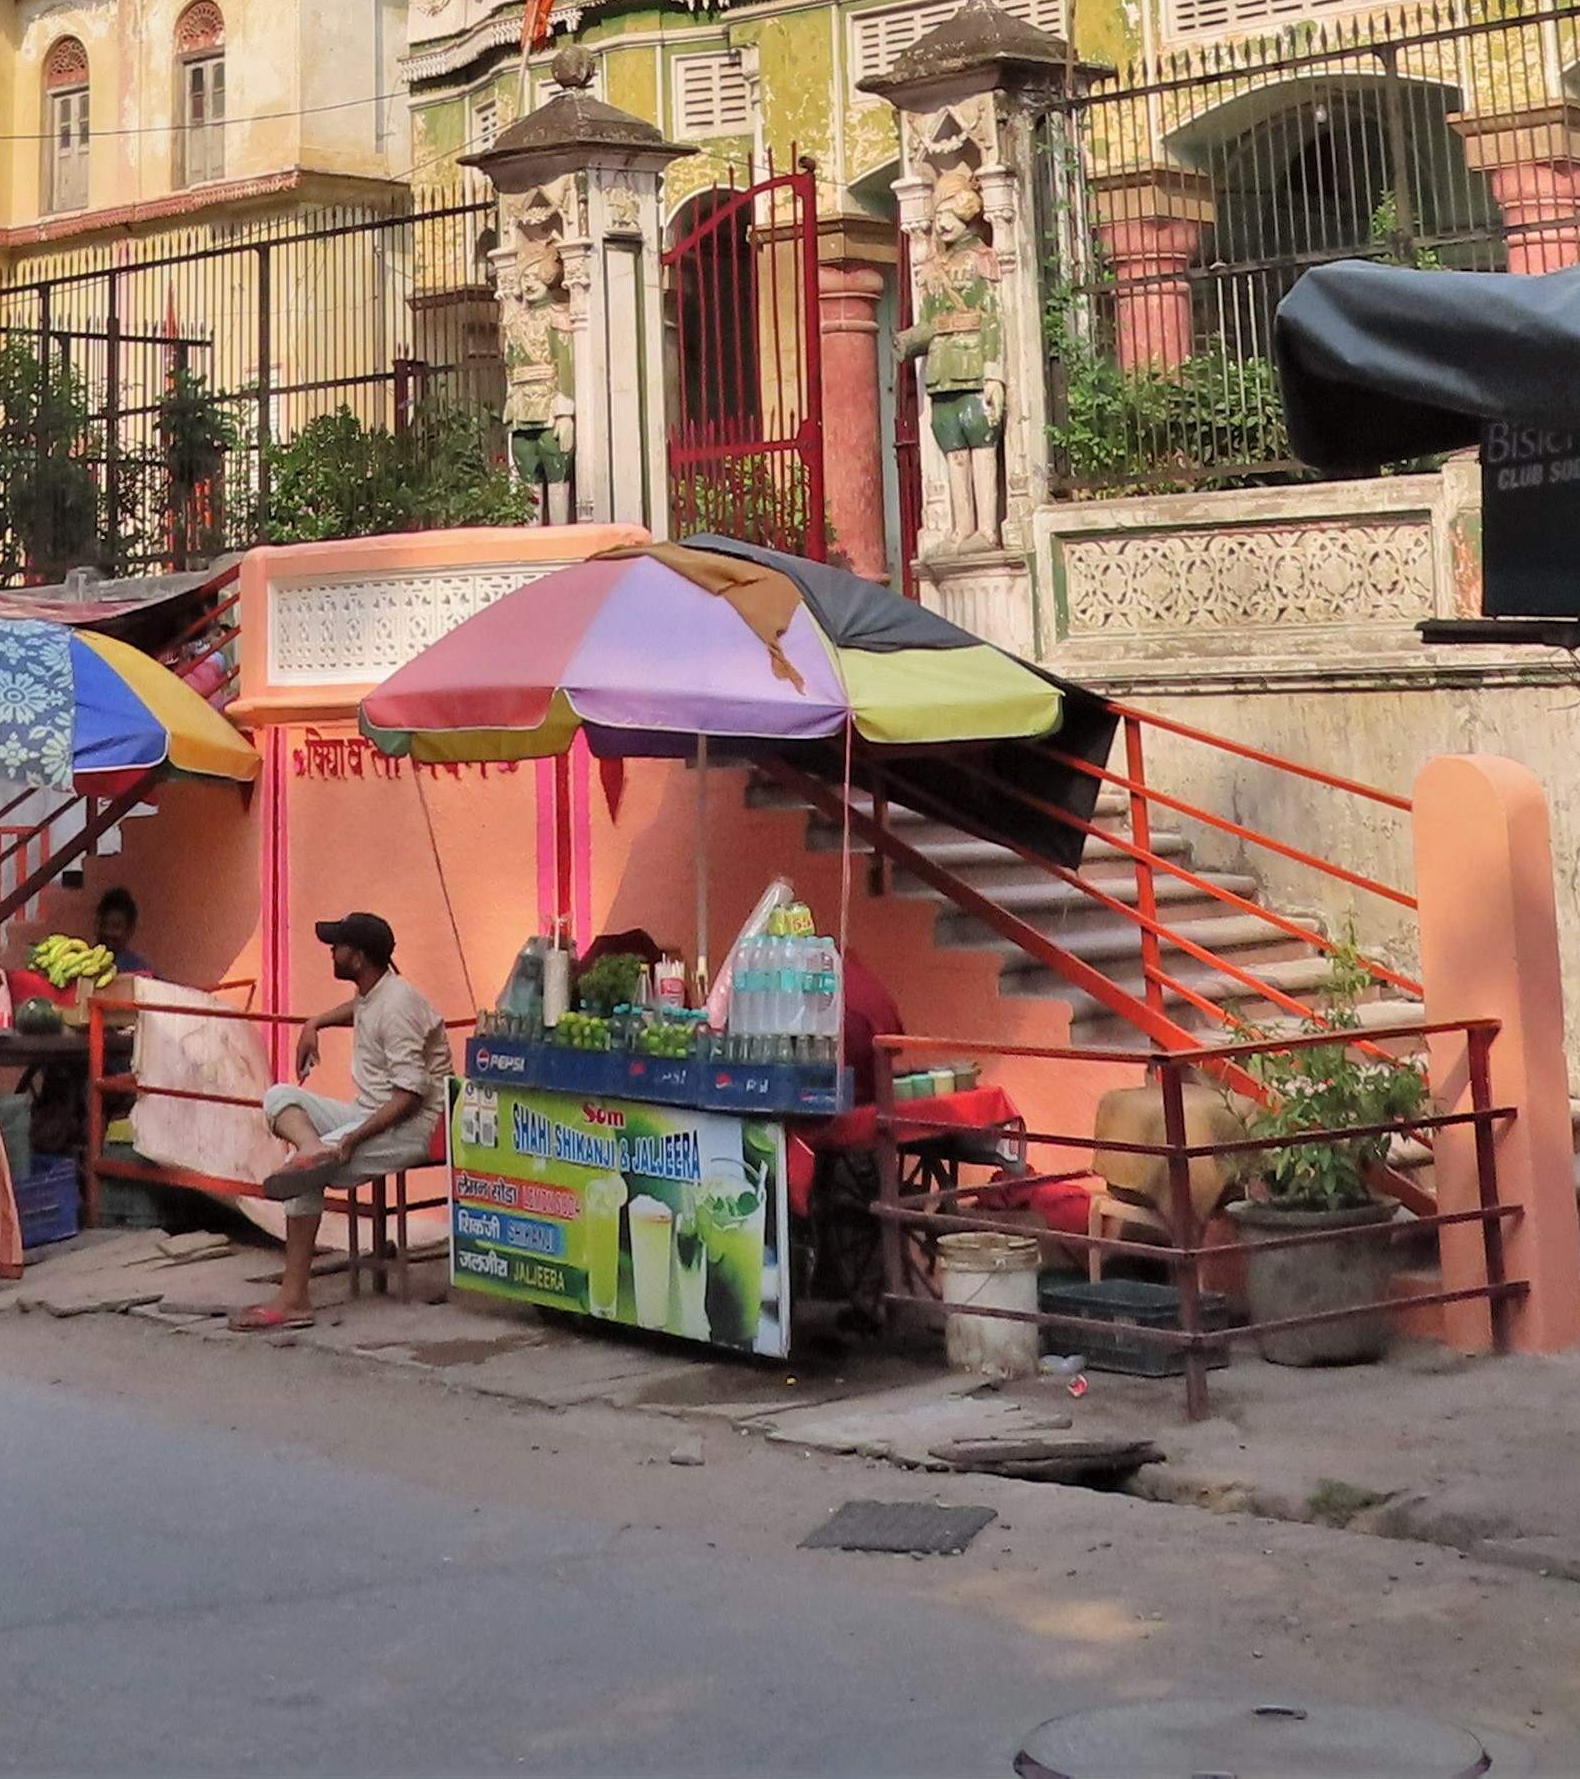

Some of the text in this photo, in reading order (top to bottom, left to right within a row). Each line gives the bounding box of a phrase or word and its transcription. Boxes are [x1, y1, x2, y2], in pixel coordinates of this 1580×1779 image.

[1497, 463, 1545, 491] CLUB
[489, 1052, 527, 1073] PEPSI
[582, 1100, 626, 1129] Som
[512, 1102, 702, 1186] SHAHI SHIKANJI & JALJEERA
[513, 1262, 566, 1291] JALJEERA
